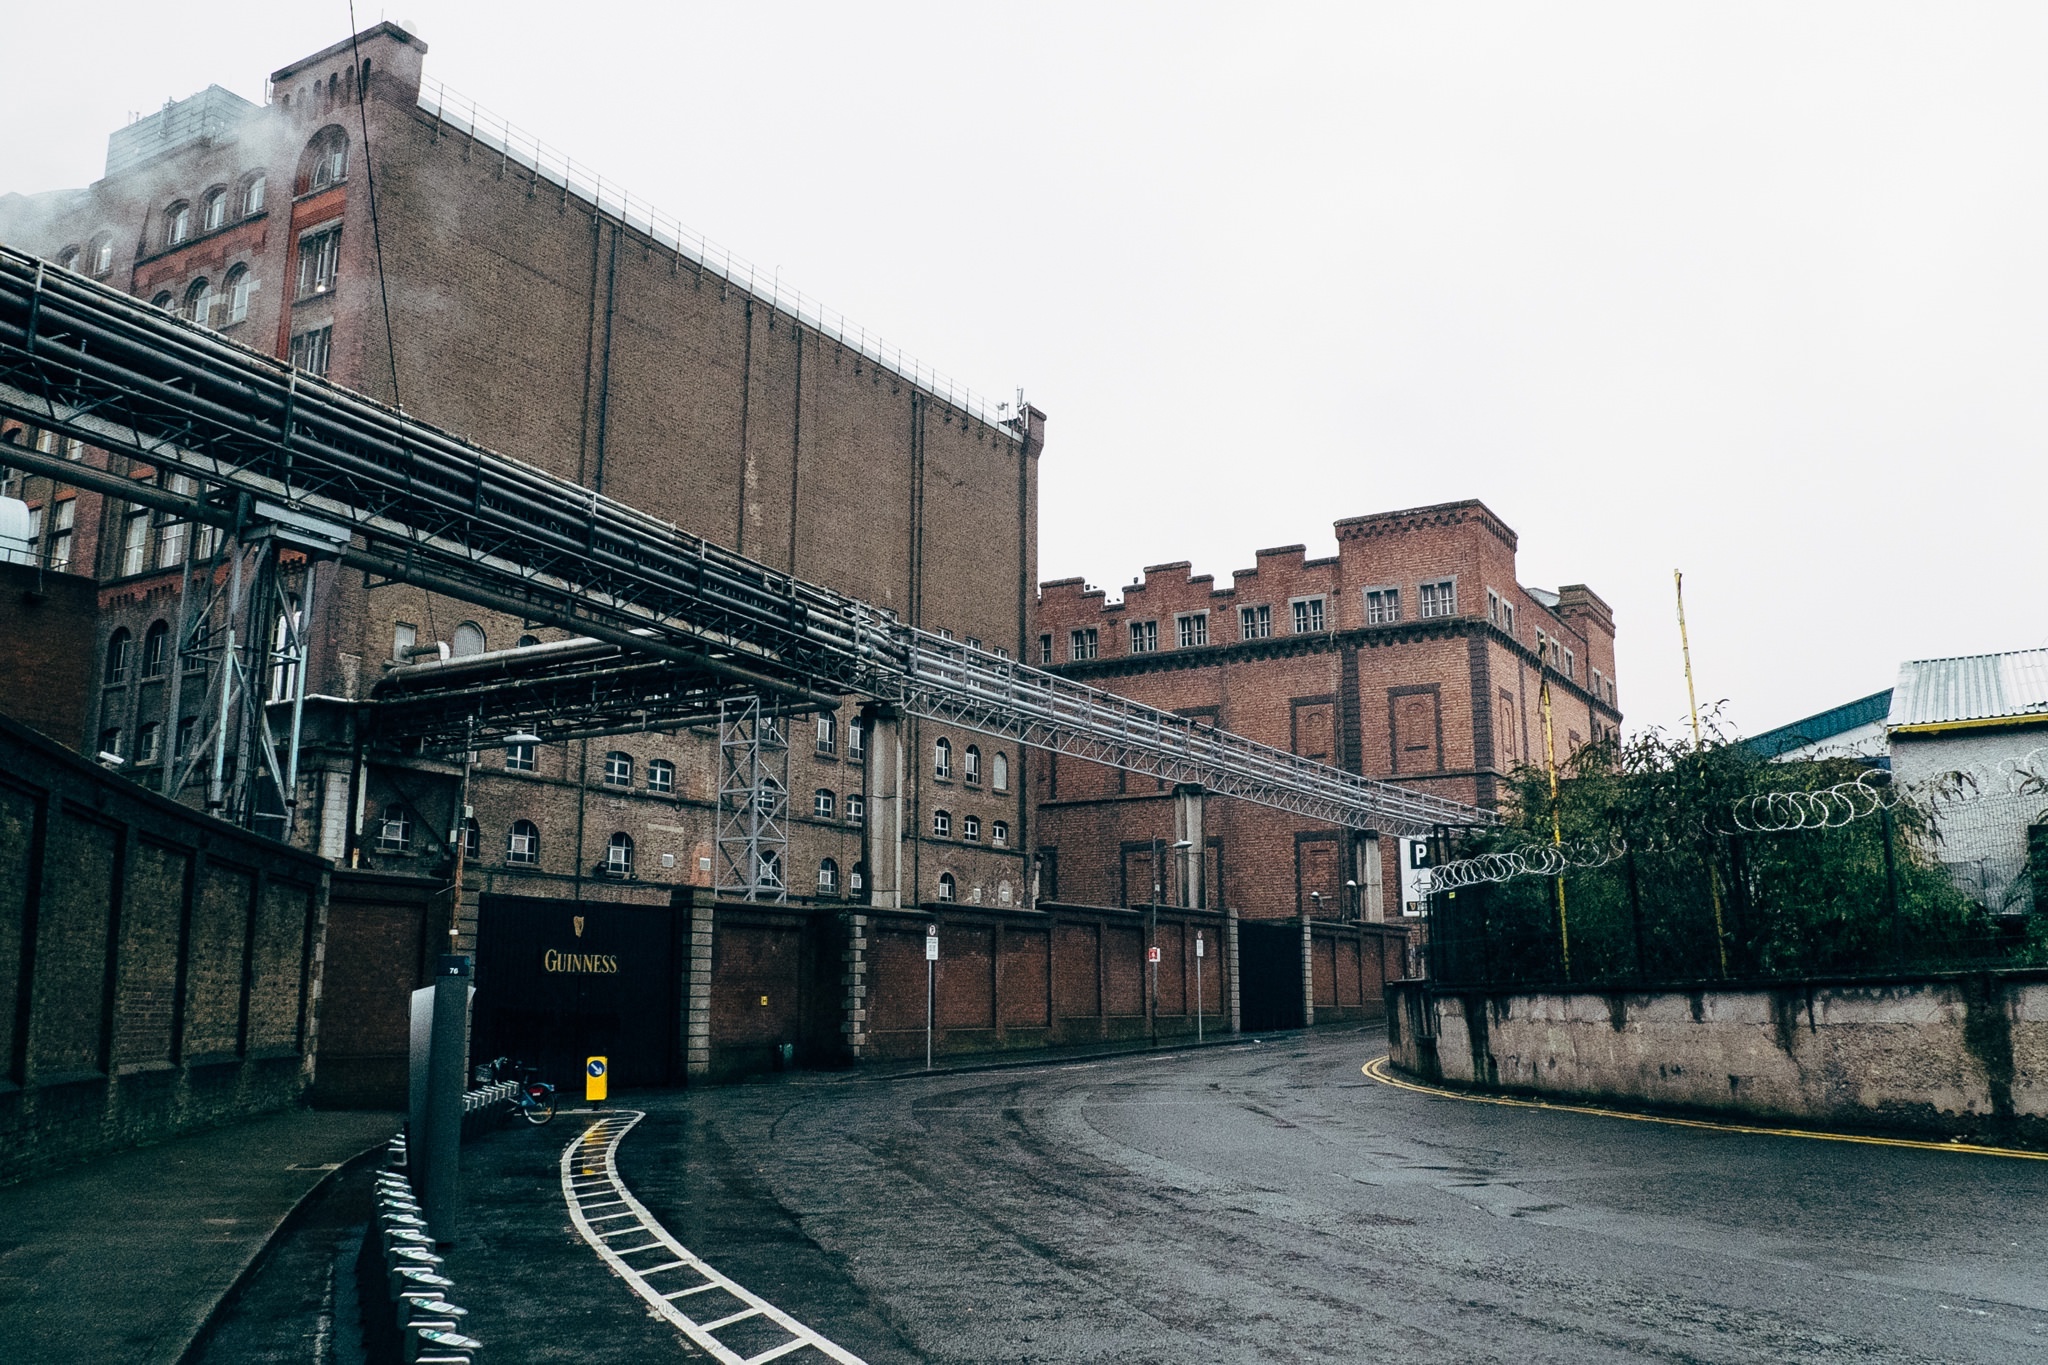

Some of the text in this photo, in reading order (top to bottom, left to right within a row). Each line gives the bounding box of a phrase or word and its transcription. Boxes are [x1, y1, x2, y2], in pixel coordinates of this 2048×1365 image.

[1415, 843, 1427, 866] P
[449, 967, 459, 975] 76
[544, 948, 617, 974] GUINNESS
